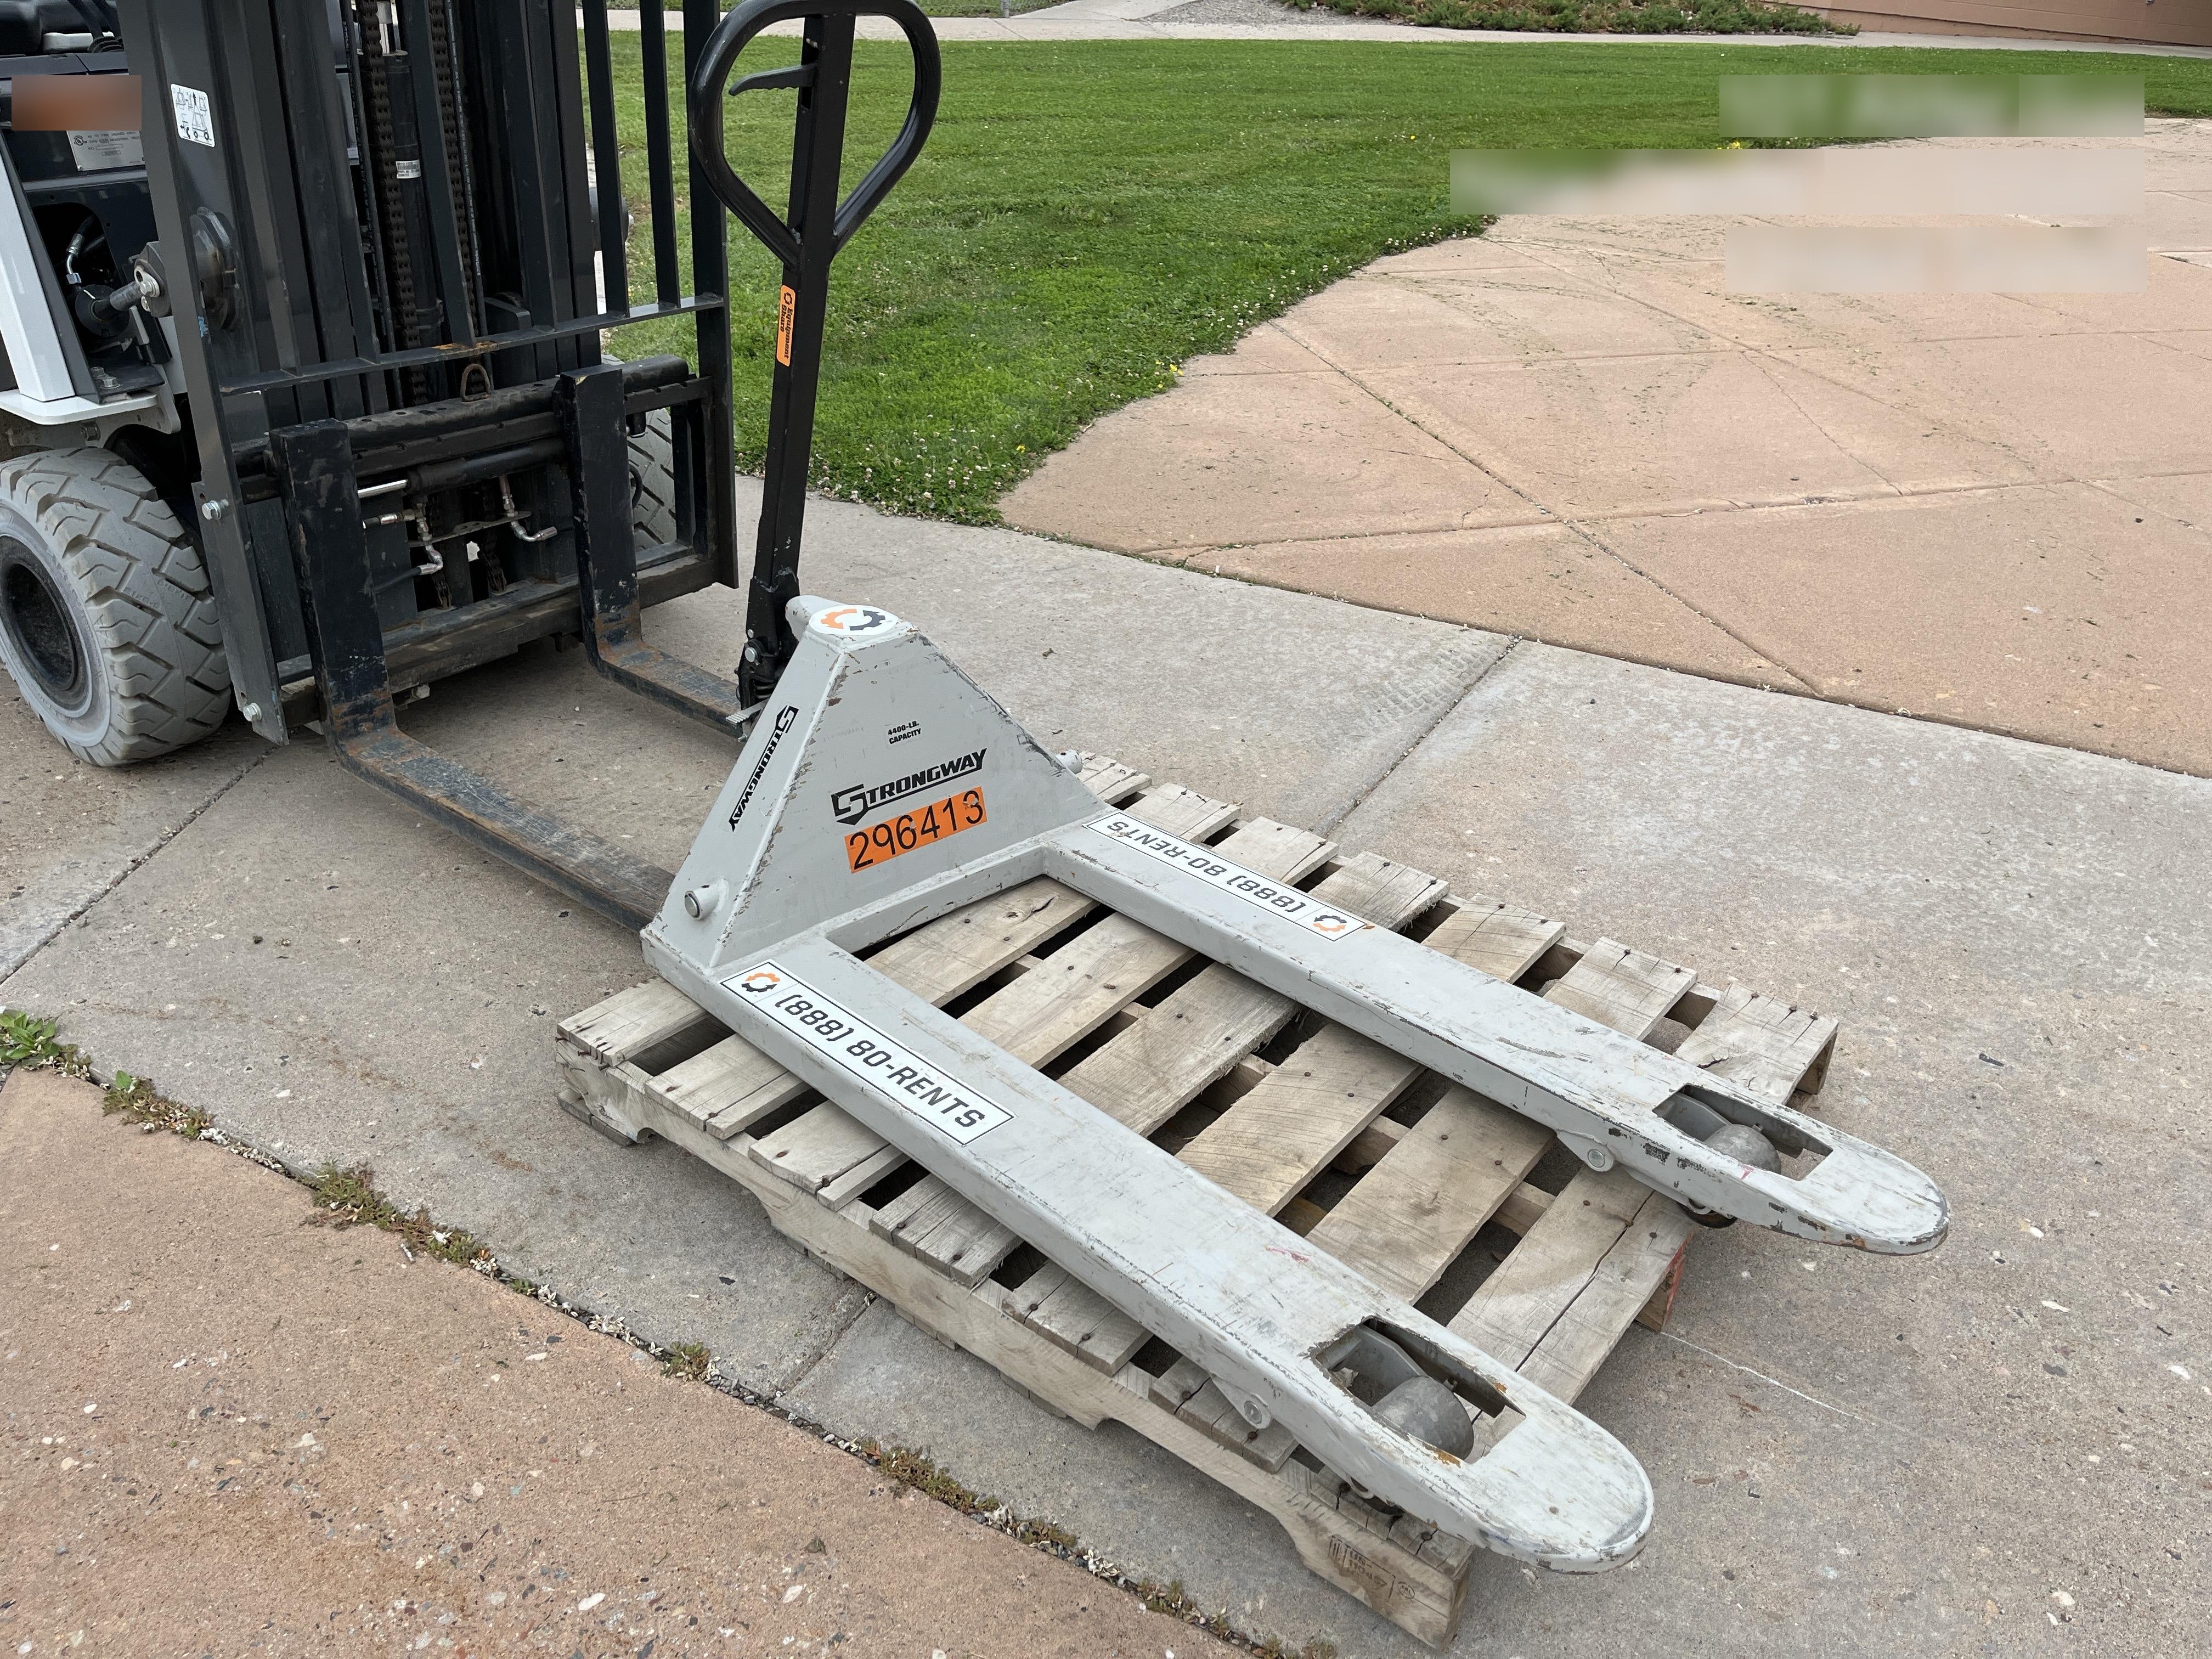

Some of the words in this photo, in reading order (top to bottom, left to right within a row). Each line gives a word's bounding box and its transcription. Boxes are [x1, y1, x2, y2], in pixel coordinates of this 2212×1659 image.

[784, 307, 793, 359] Equipment
[888, 720, 919, 735] 4400-LB.
[889, 728, 922, 744] CAPACITY
[729, 704, 799, 832] STRONGWAY
[830, 748, 988, 826] STRONGWAY
[849, 790, 984, 870] 296413
[1107, 821, 1228, 877] 80-RENTS
[1226, 875, 1306, 913] (888)
[774, 994, 854, 1042] (888)
[846, 1040, 985, 1127] 80-RENTS
